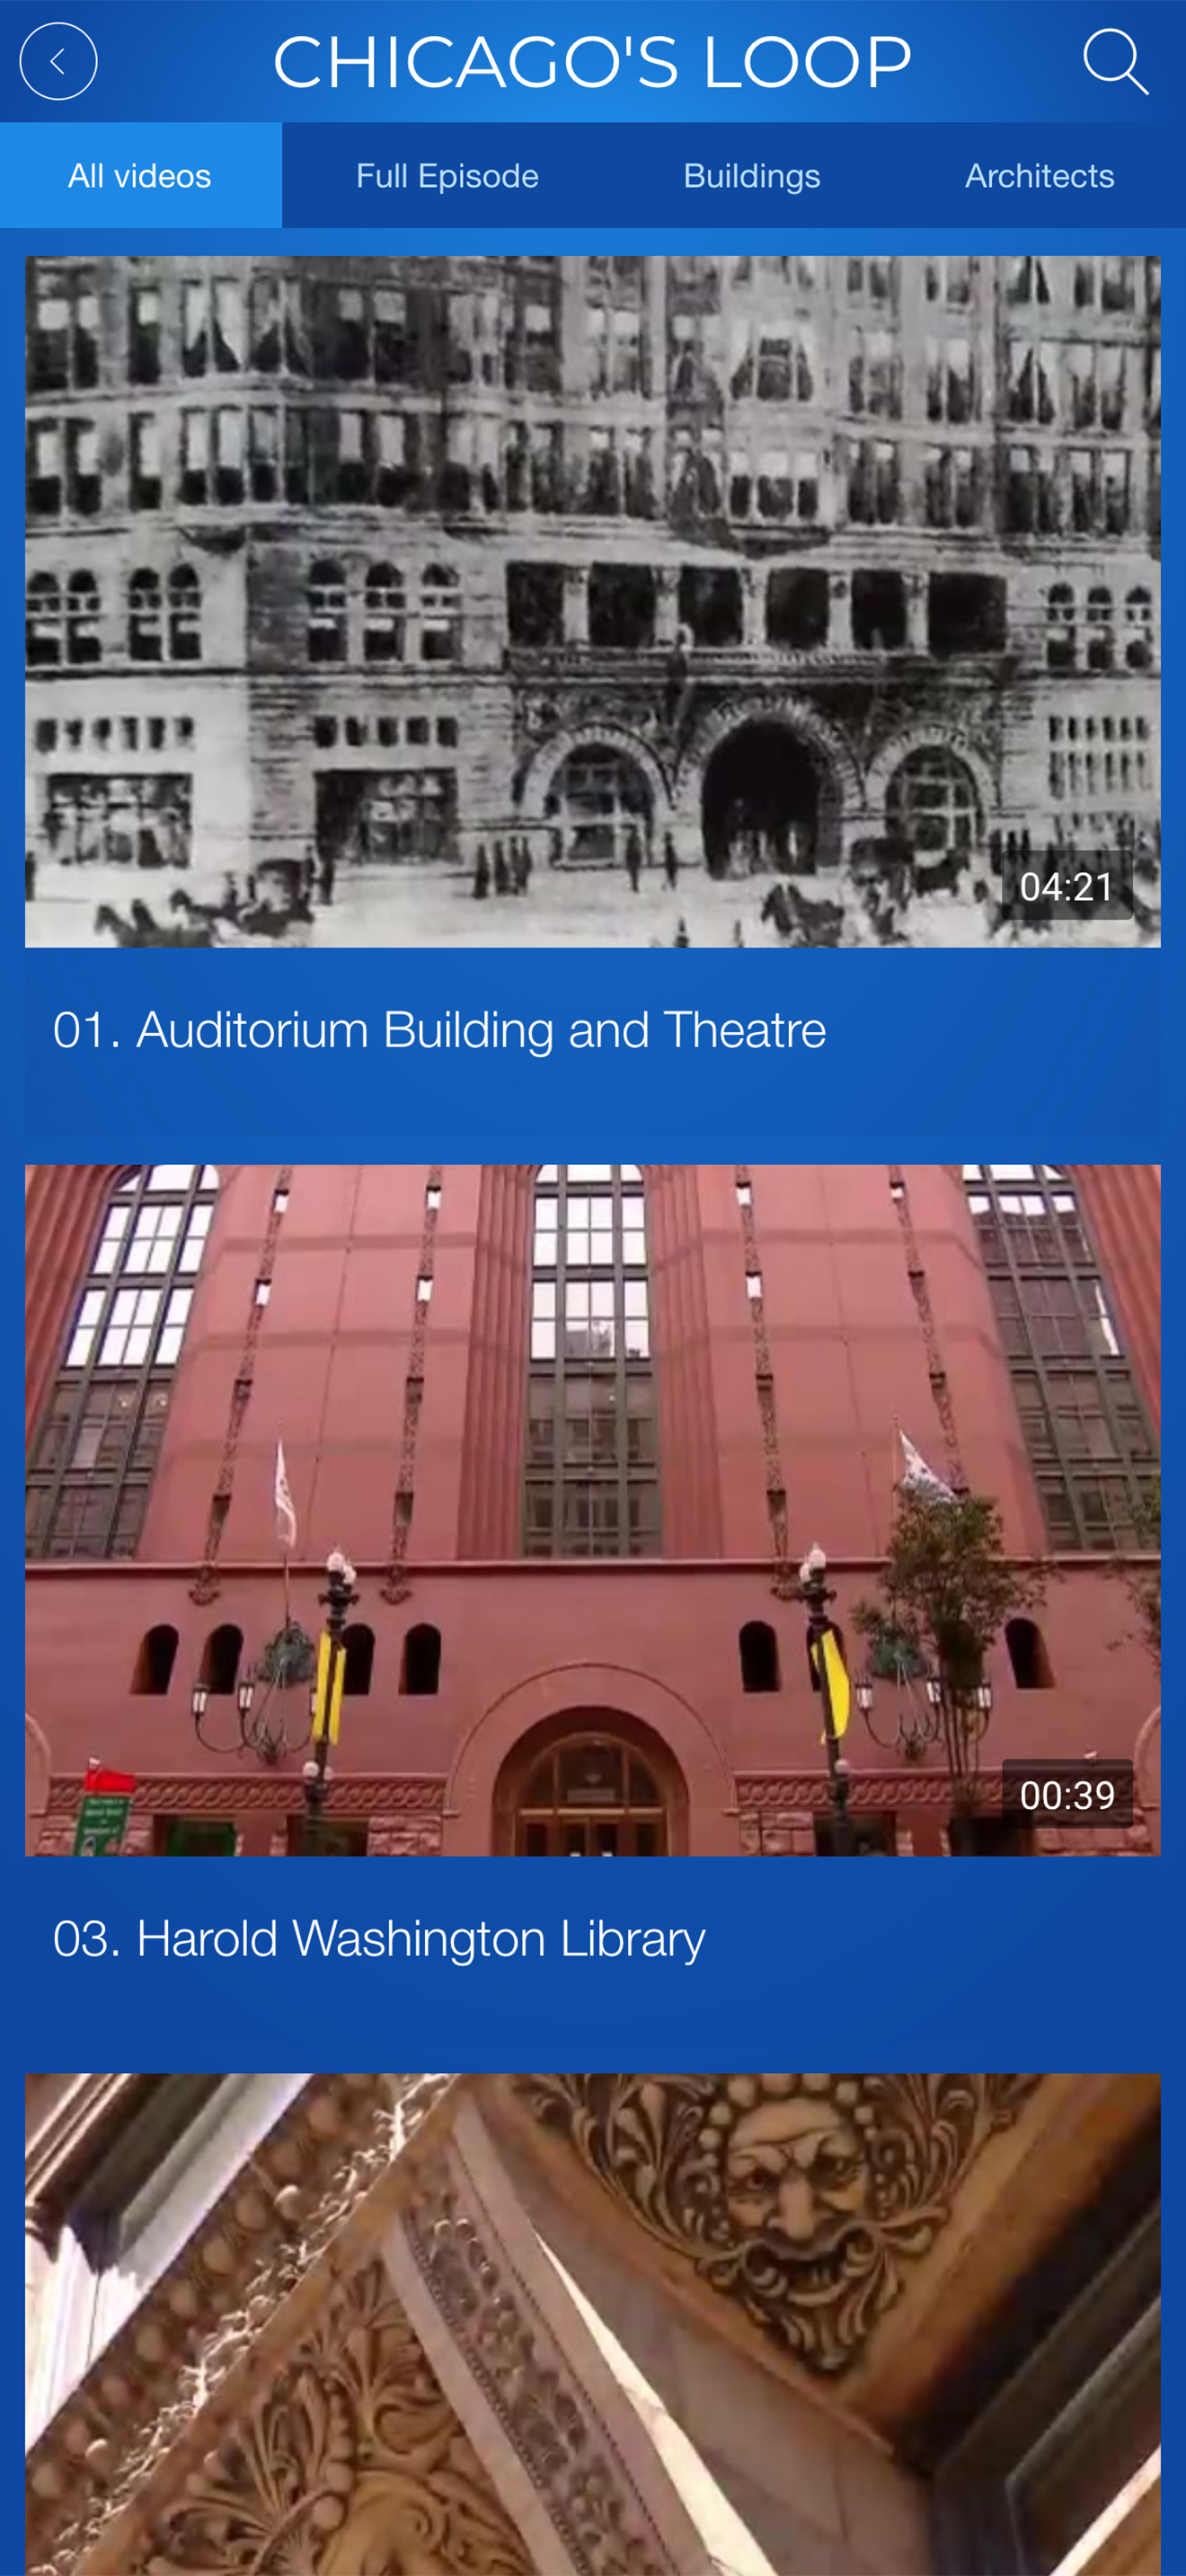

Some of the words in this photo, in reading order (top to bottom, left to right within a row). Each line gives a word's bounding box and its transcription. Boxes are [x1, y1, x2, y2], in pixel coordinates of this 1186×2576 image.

[274, 35, 678, 89] CHICAGO'S
[707, 35, 911, 89] LOOP
[67, 163, 103, 189] All
[113, 163, 211, 189] videos
[358, 163, 407, 189] Full
[420, 163, 539, 195] Episode
[685, 163, 820, 195] Buildings
[965, 163, 1115, 189] Architects
[1021, 871, 1111, 902] 04:21
[54, 1010, 119, 1048] 01.
[136, 1010, 367, 1048] Auditorium
[385, 1010, 553, 1058] Building
[570, 1010, 649, 1048] and
[663, 1010, 827, 1048] Theatre
[1021, 1780, 1115, 1810] 00:39
[54, 1919, 119, 1957] 03.
[139, 1919, 277, 1957] Harold
[292, 1919, 544, 1967] Washington
[563, 1919, 706, 1966] Library
